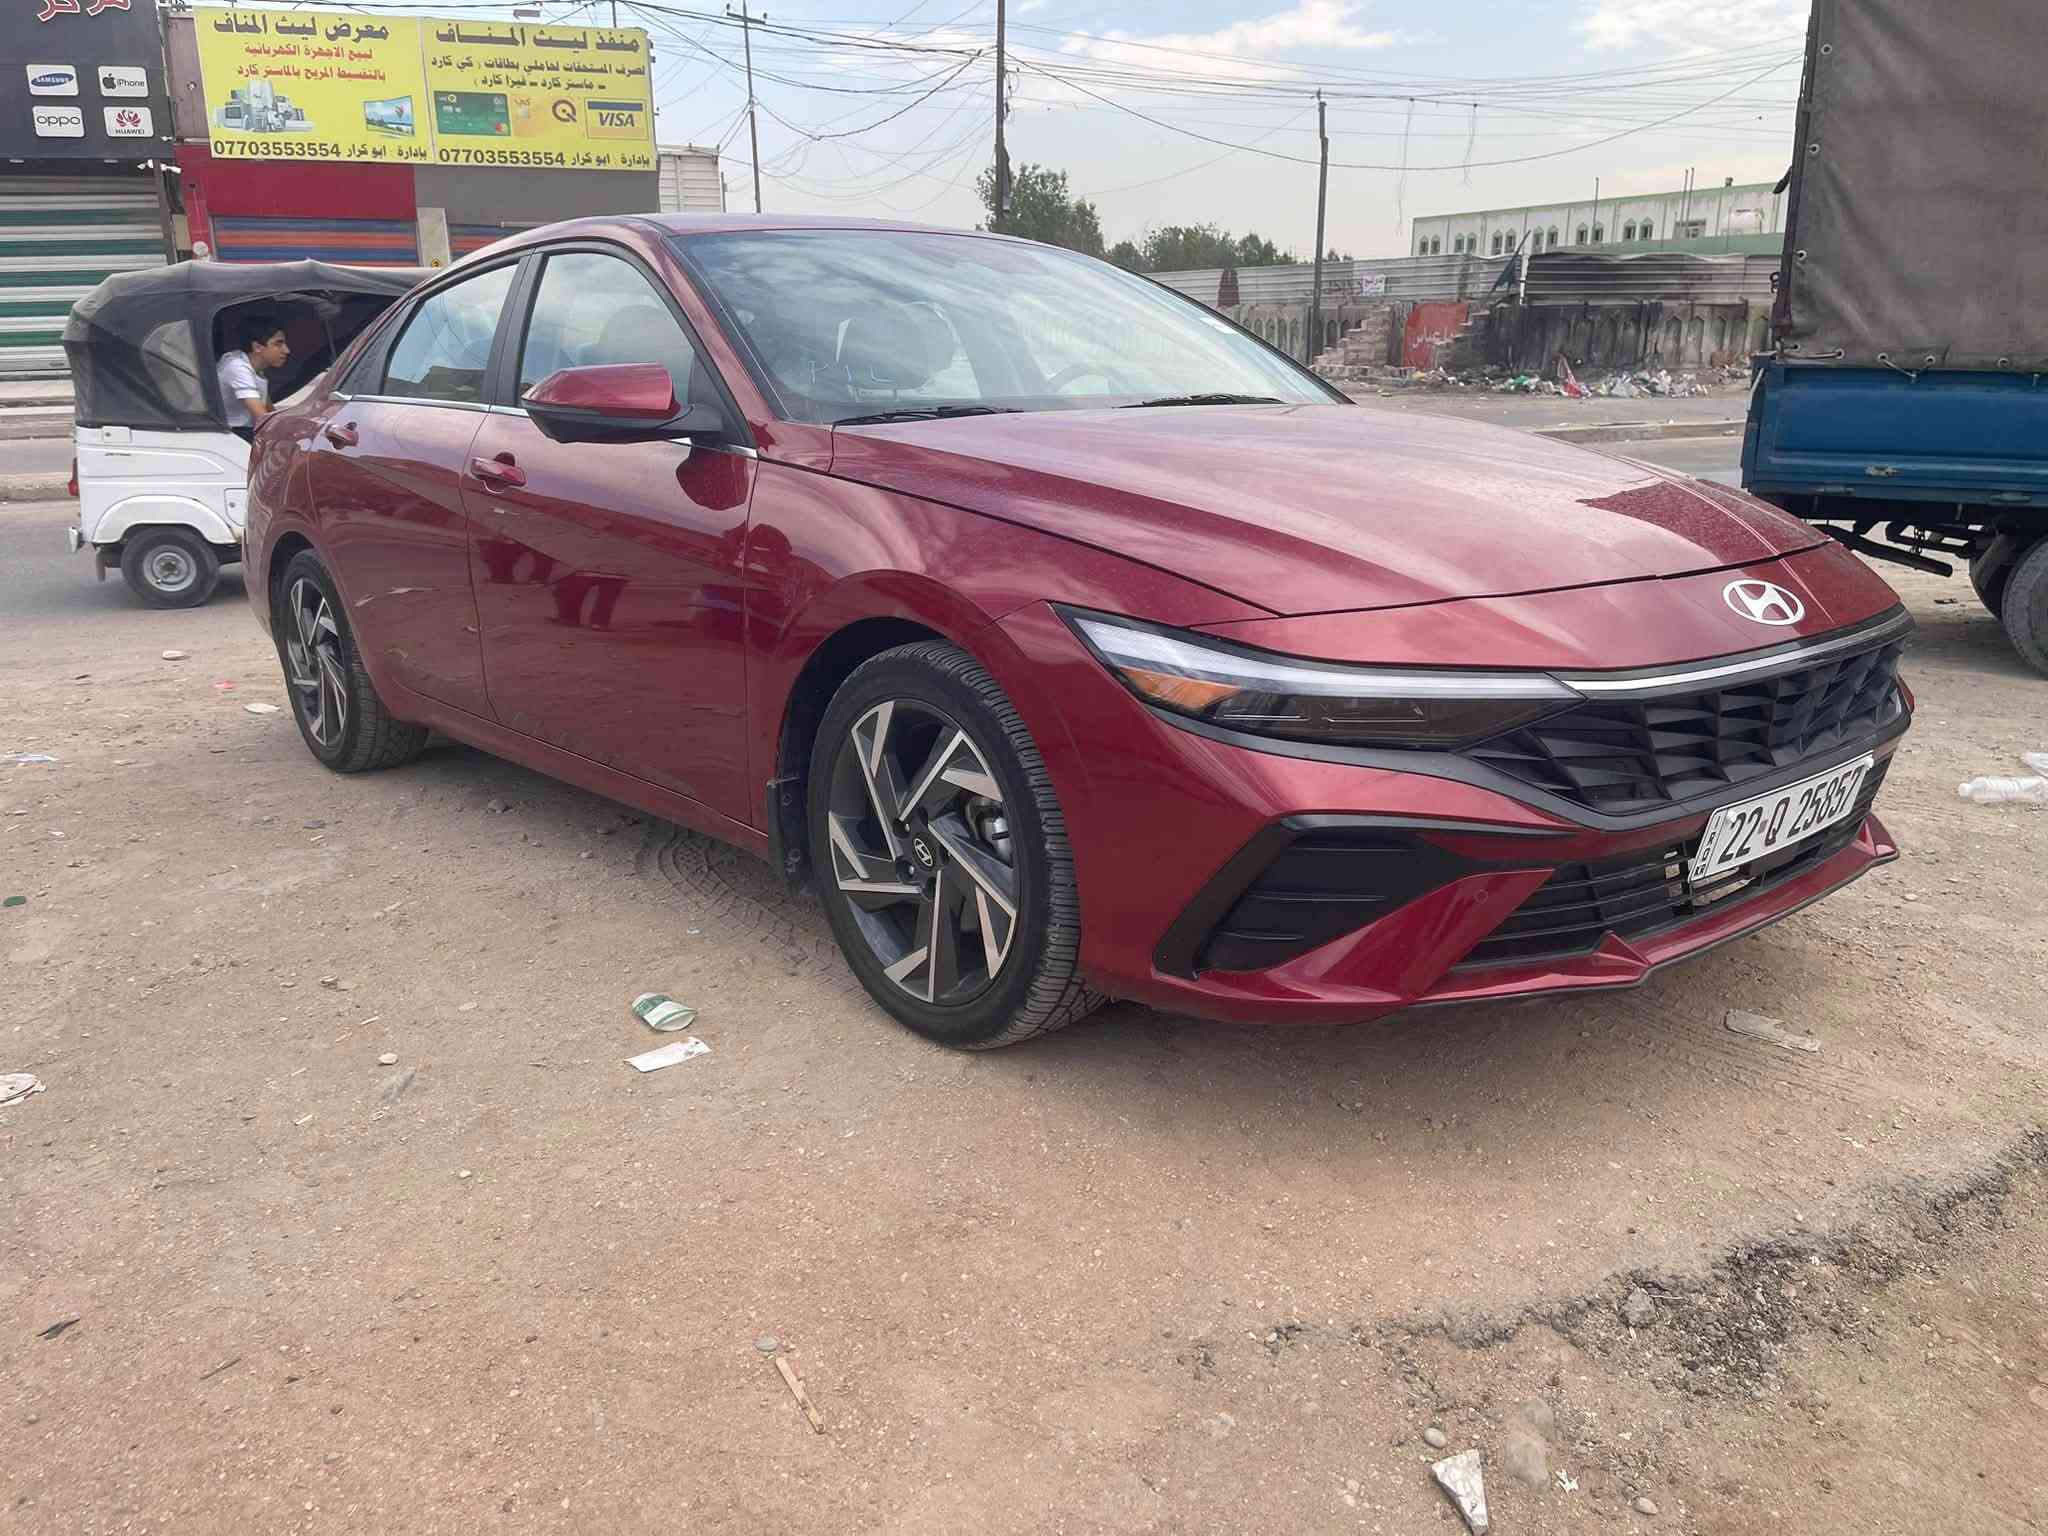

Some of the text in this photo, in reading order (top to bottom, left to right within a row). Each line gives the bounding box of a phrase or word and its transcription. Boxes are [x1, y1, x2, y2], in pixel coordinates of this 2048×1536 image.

[214, 12, 389, 43] معرض ليث المناف
[436, 23, 640, 53] منفذ ليث المناف
[349, 48, 373, 61] لبيع
[431, 55, 451, 68] كارد
[456, 56, 473, 71] كي
[484, 57, 519, 70] بطاقات
[523, 59, 560, 73] لحاملي
[563, 61, 612, 75] المستحقات
[615, 64, 645, 77] لصرف
[238, 63, 386, 81] بالتقسيط المريح بالماستر كارد
[481, 73, 503, 88] كارد
[506, 73, 527, 89] فيزا
[541, 76, 561, 90] كارد
[564, 76, 593, 90] ماستر
[599, 112, 635, 127] VISA
[214, 140, 341, 158] 07703553554
[347, 143, 369, 158] كرار
[439, 148, 566, 166] 07703553554
[571, 152, 592, 166] كرار
[1718, 807, 1764, 865] 22
[1787, 764, 1867, 838] 25857
